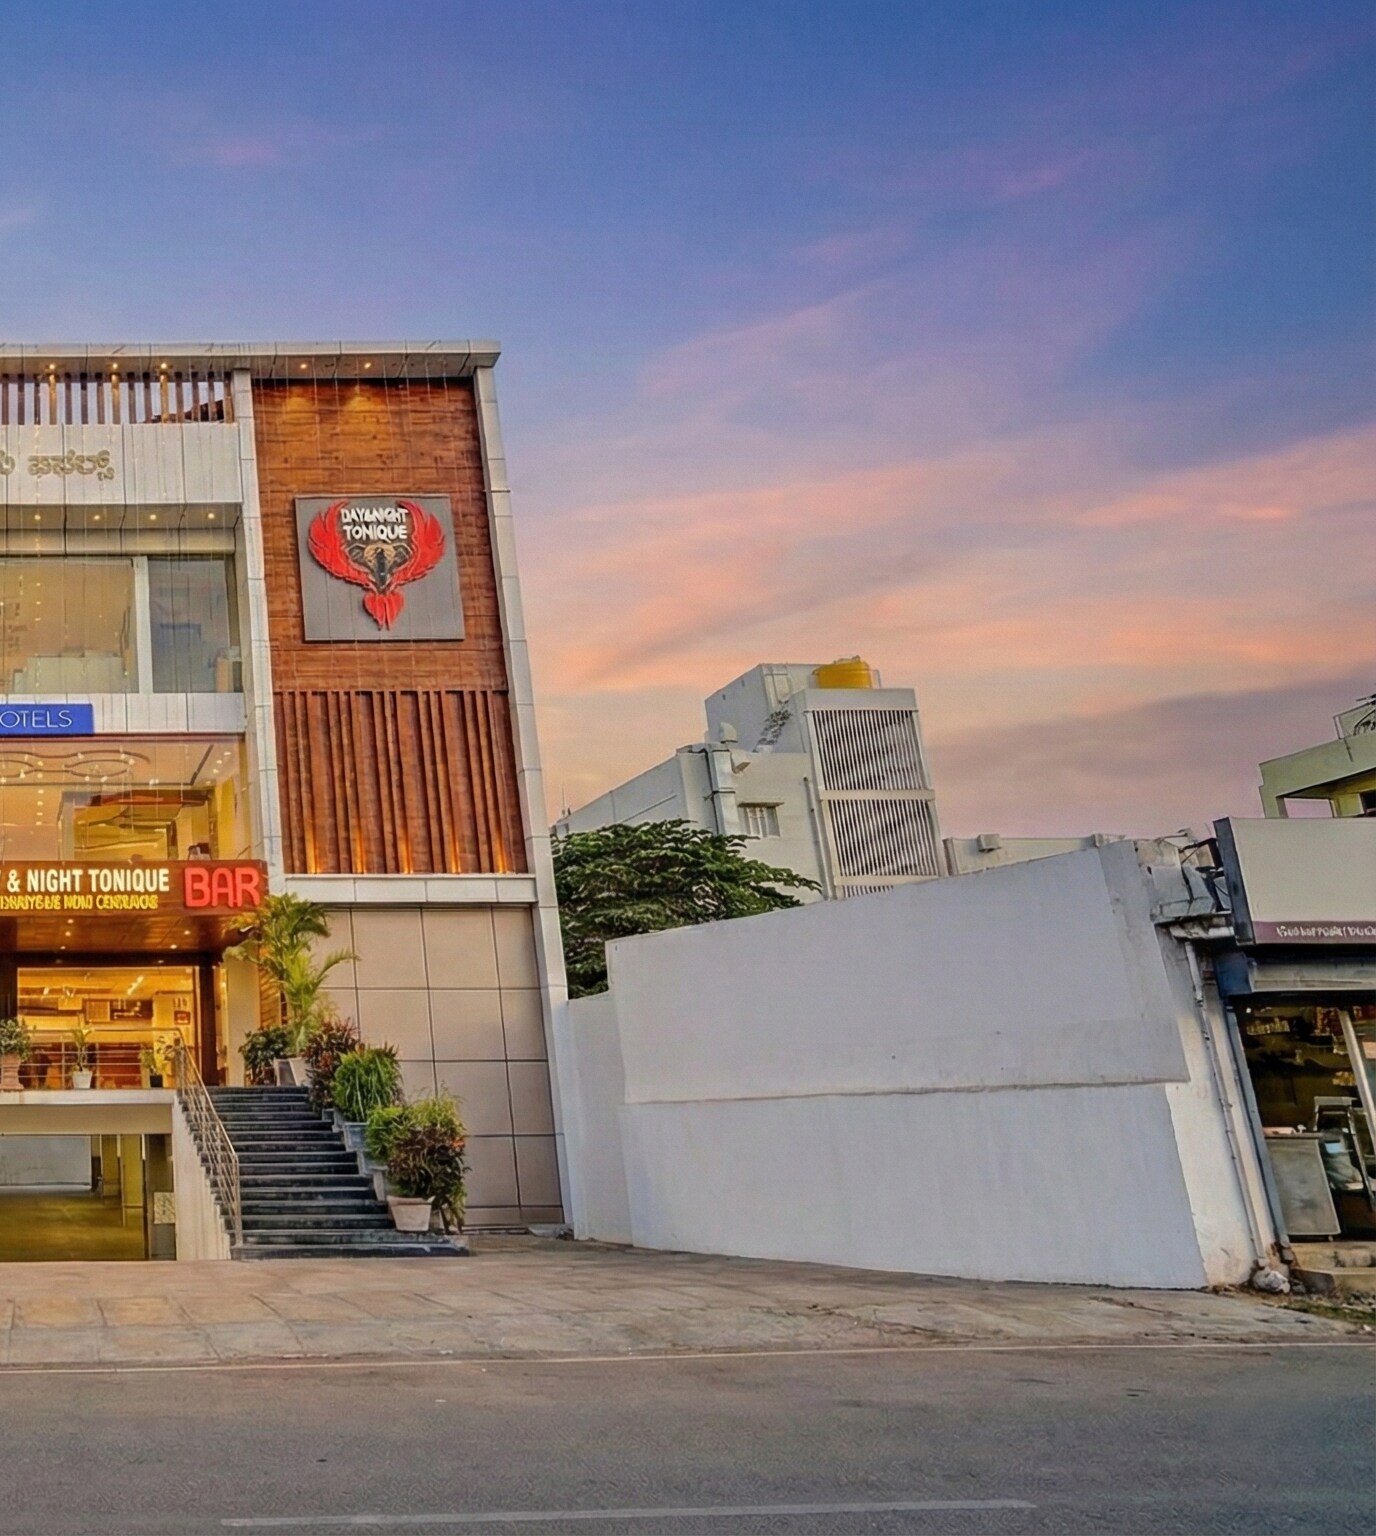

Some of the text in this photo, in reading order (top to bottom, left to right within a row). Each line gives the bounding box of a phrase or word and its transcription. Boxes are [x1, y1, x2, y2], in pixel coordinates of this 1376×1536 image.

[343, 525, 408, 543] TONIQUE
[7, 870, 20, 892] &
[27, 869, 83, 892] NIGHT
[88, 868, 170, 893] TONIQUE
[184, 866, 260, 907] BAR
